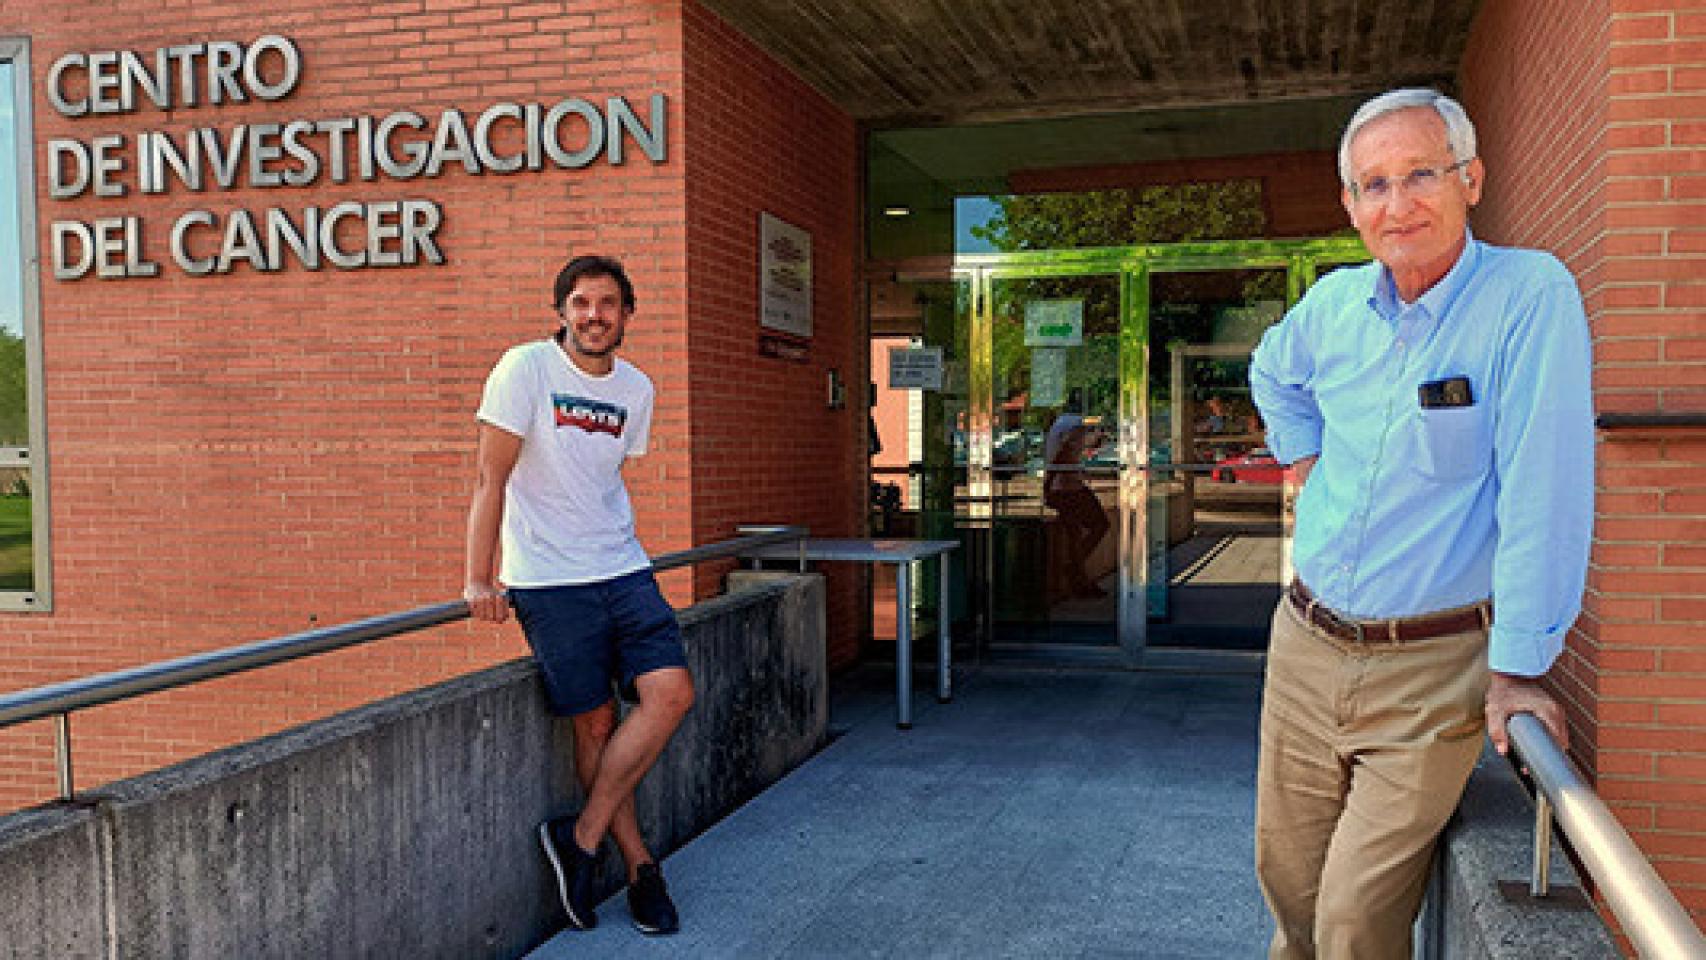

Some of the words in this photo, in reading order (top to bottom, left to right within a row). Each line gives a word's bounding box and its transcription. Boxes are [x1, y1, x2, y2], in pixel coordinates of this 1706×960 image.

[47, 35, 300, 116] CENTRO
[48, 135, 126, 199] DE
[137, 94, 668, 195] INVESTIGACION
[52, 217, 159, 281] DEL
[169, 199, 446, 275] CANCER
